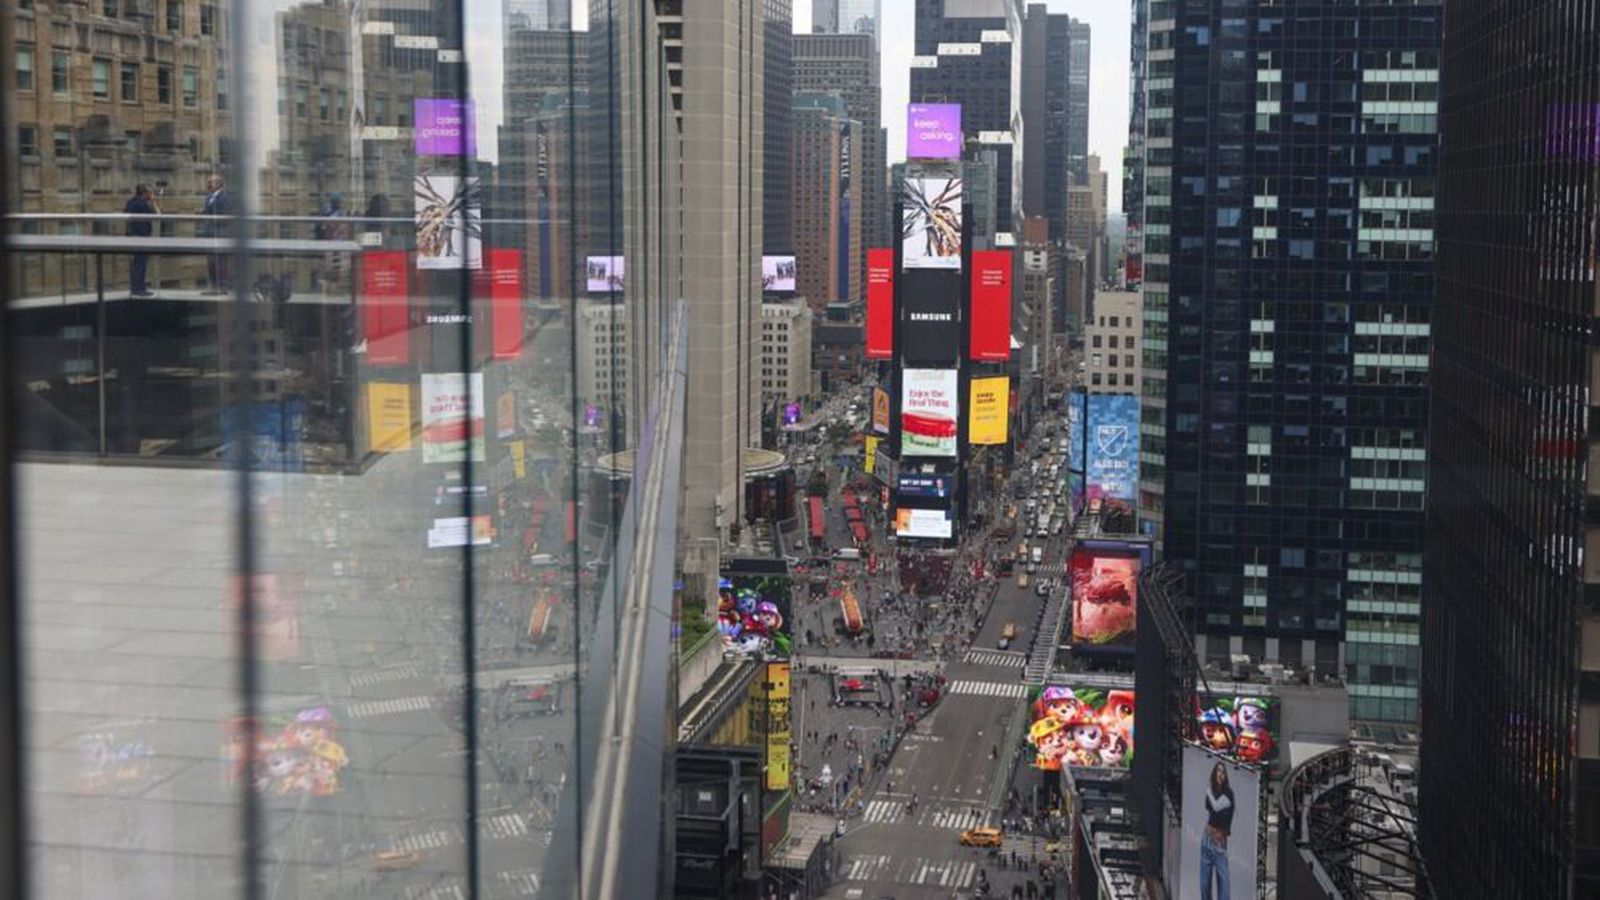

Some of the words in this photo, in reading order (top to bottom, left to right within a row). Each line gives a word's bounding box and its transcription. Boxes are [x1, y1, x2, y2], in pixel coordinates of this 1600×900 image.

[914, 118, 940, 131] keep
[910, 313, 952, 321] SAMSUNG
[909, 390, 929, 398] Enjoy
[928, 399, 949, 408] Thing
